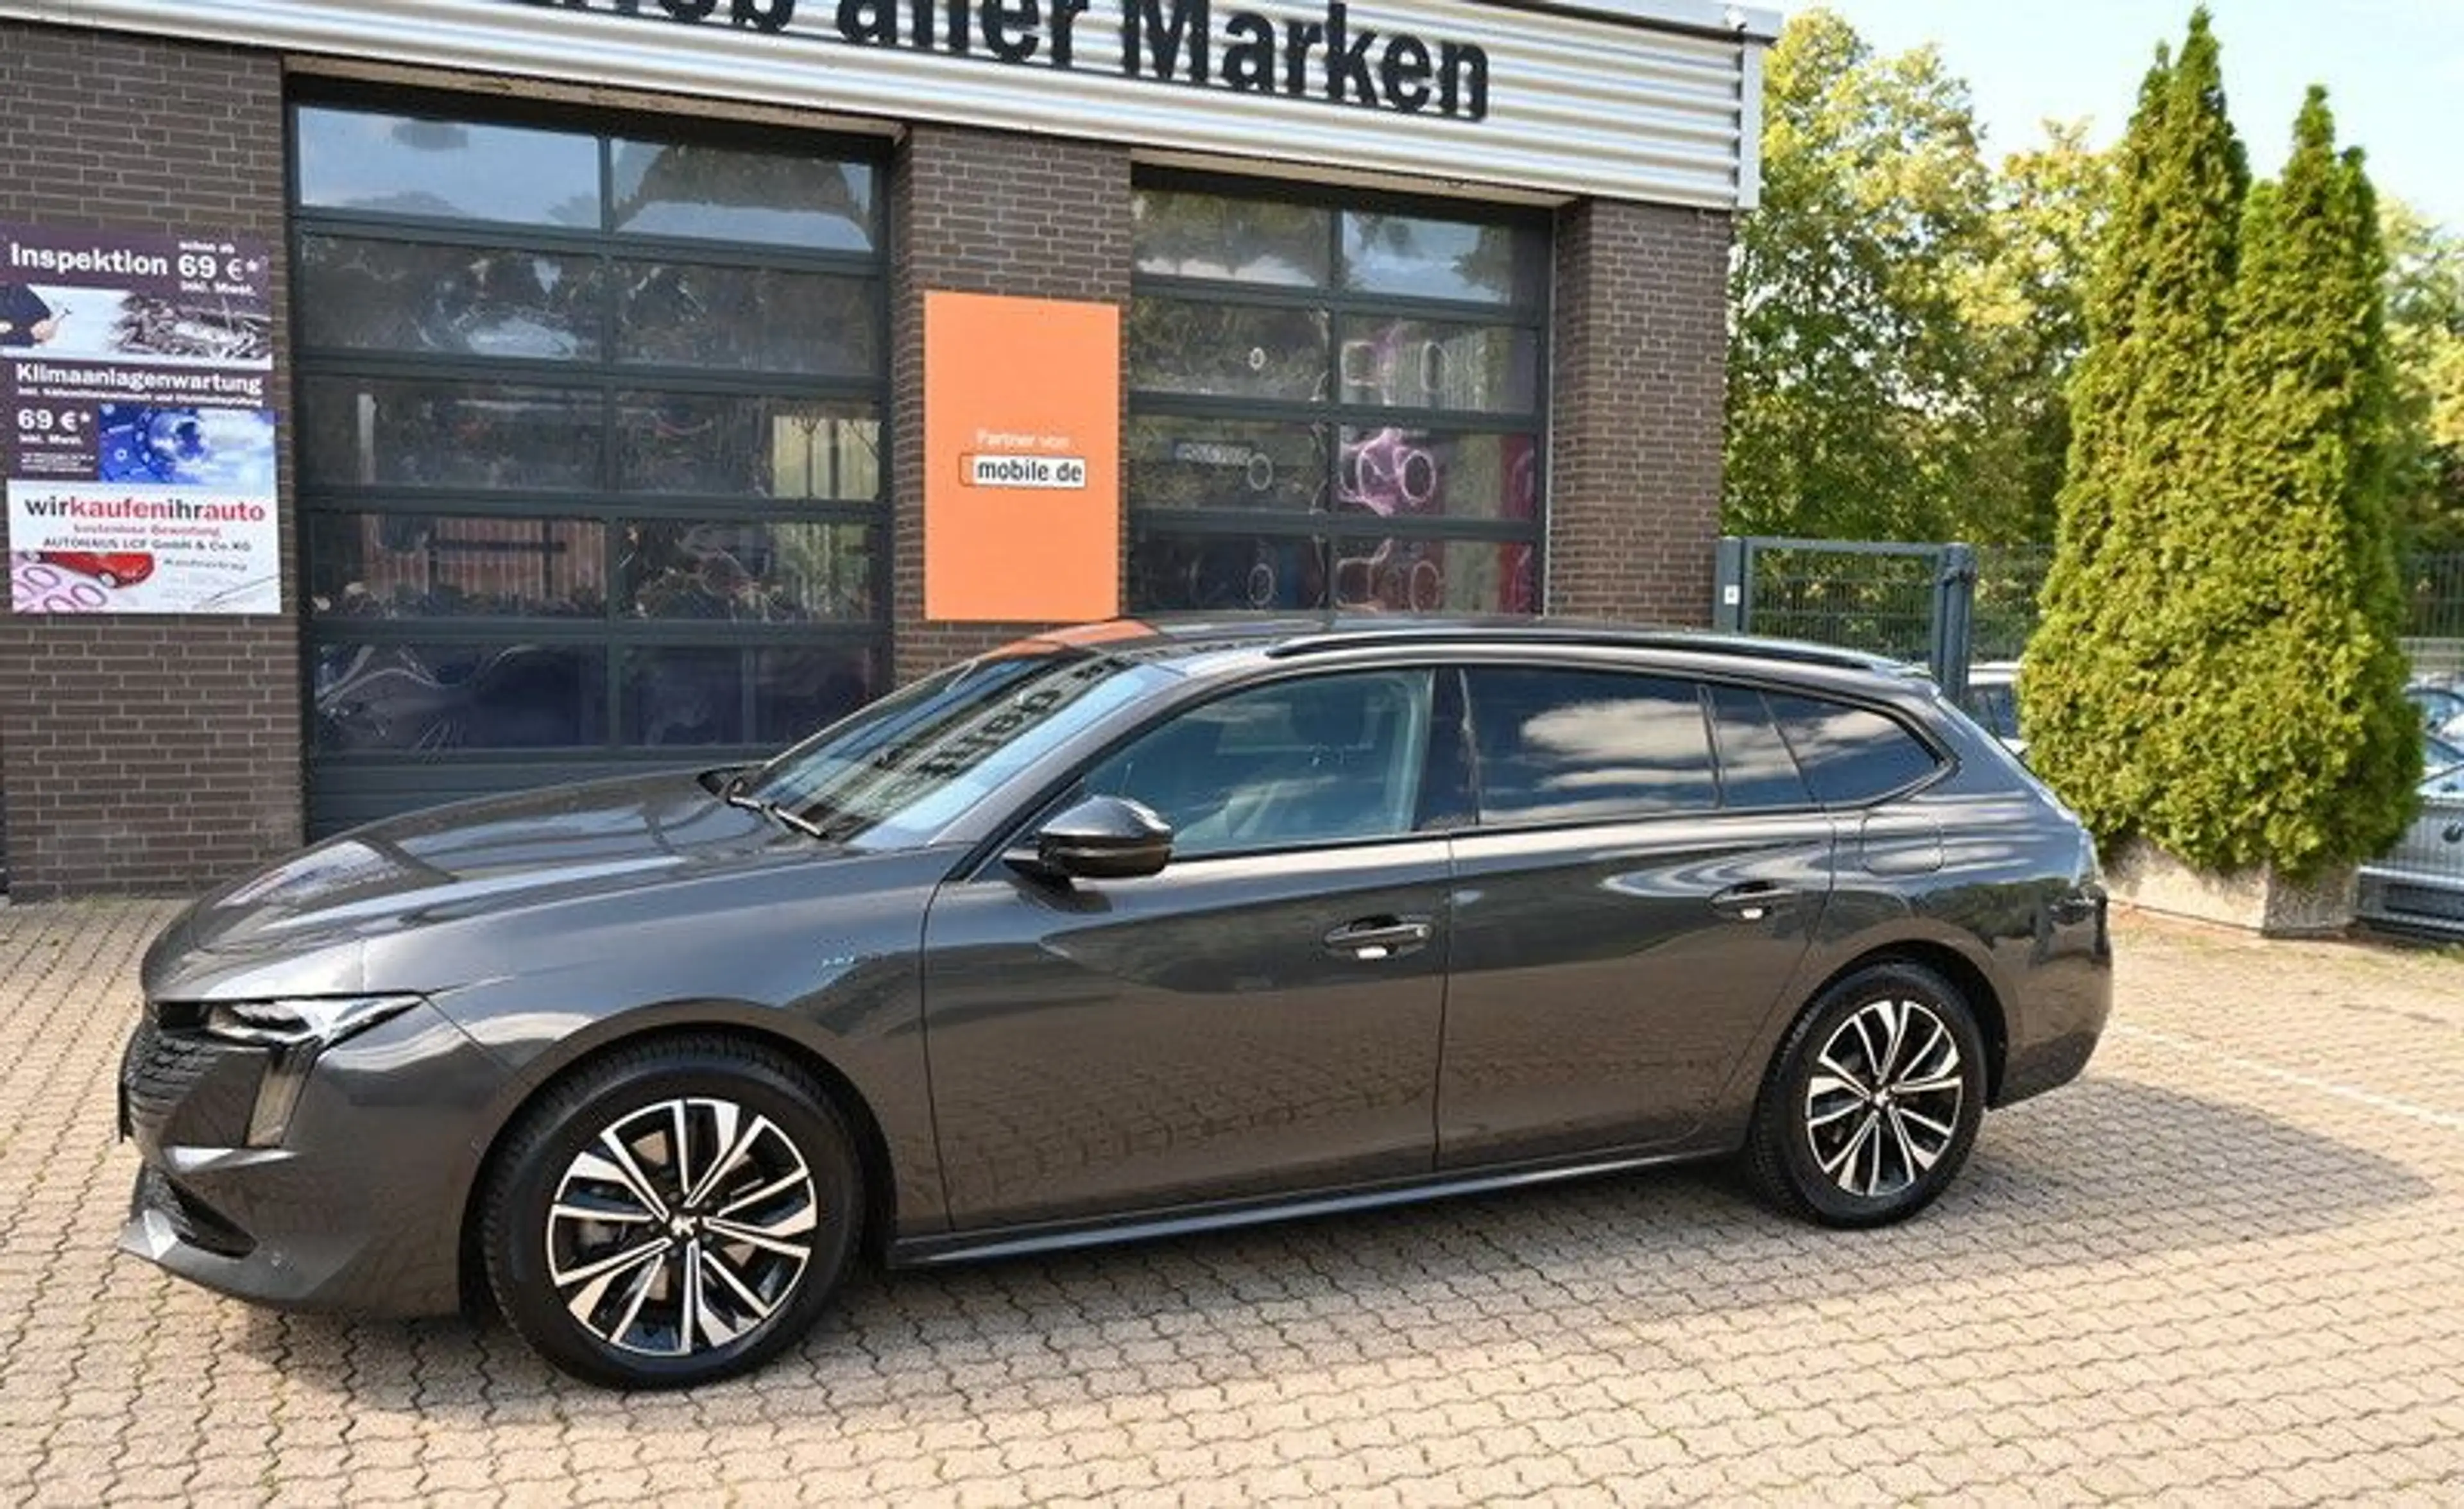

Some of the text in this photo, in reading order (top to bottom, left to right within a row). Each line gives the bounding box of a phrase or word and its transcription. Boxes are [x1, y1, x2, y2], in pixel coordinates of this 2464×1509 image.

[1122, 0, 1489, 121] Marken
[10, 241, 168, 275] Inspektion
[178, 254, 217, 278] 69
[15, 363, 263, 395] Klimaanlagenwartung
[18, 409, 54, 430] 69
[24, 496, 266, 522] wirkaufenihrauto
